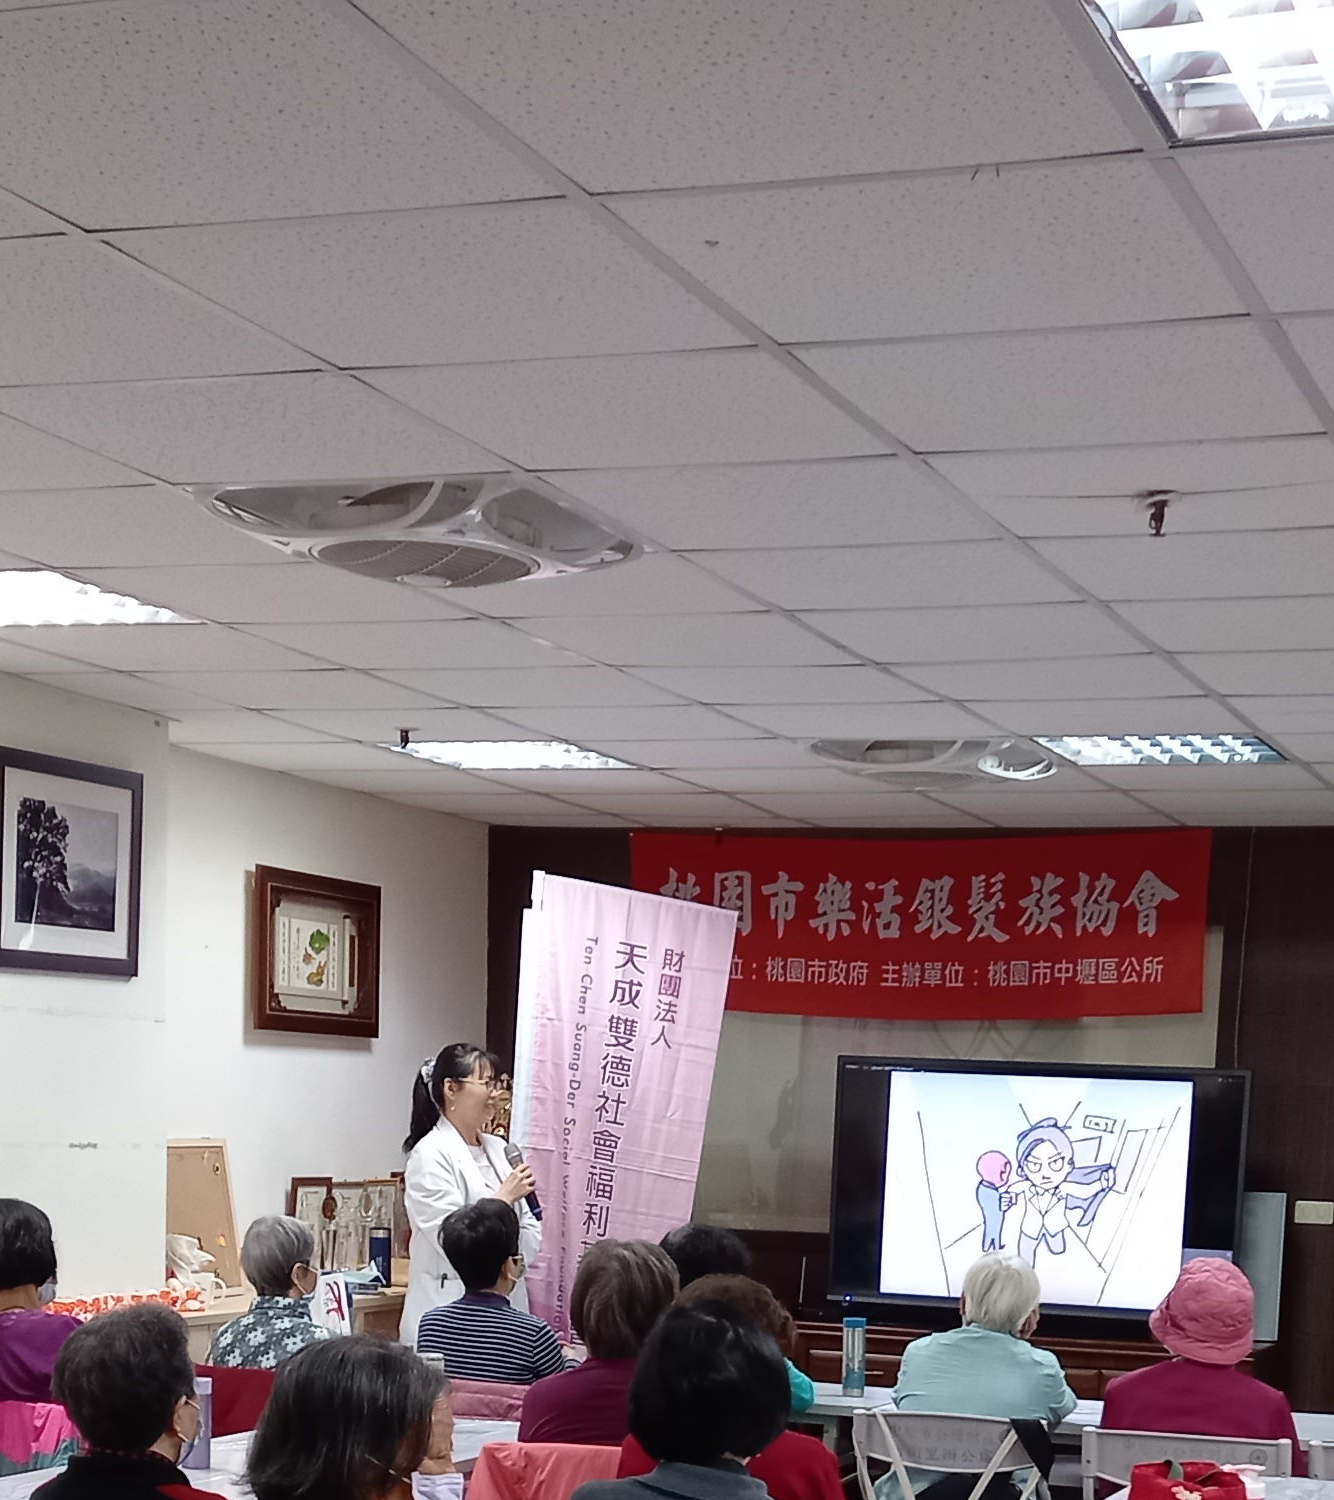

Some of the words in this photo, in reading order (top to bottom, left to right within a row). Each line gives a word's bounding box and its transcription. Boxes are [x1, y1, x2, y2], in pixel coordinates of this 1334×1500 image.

[576, 973, 594, 1016] Chen
[650, 947, 686, 1050] 財團法人
[578, 940, 648, 1264] 天成雙德社會福利
